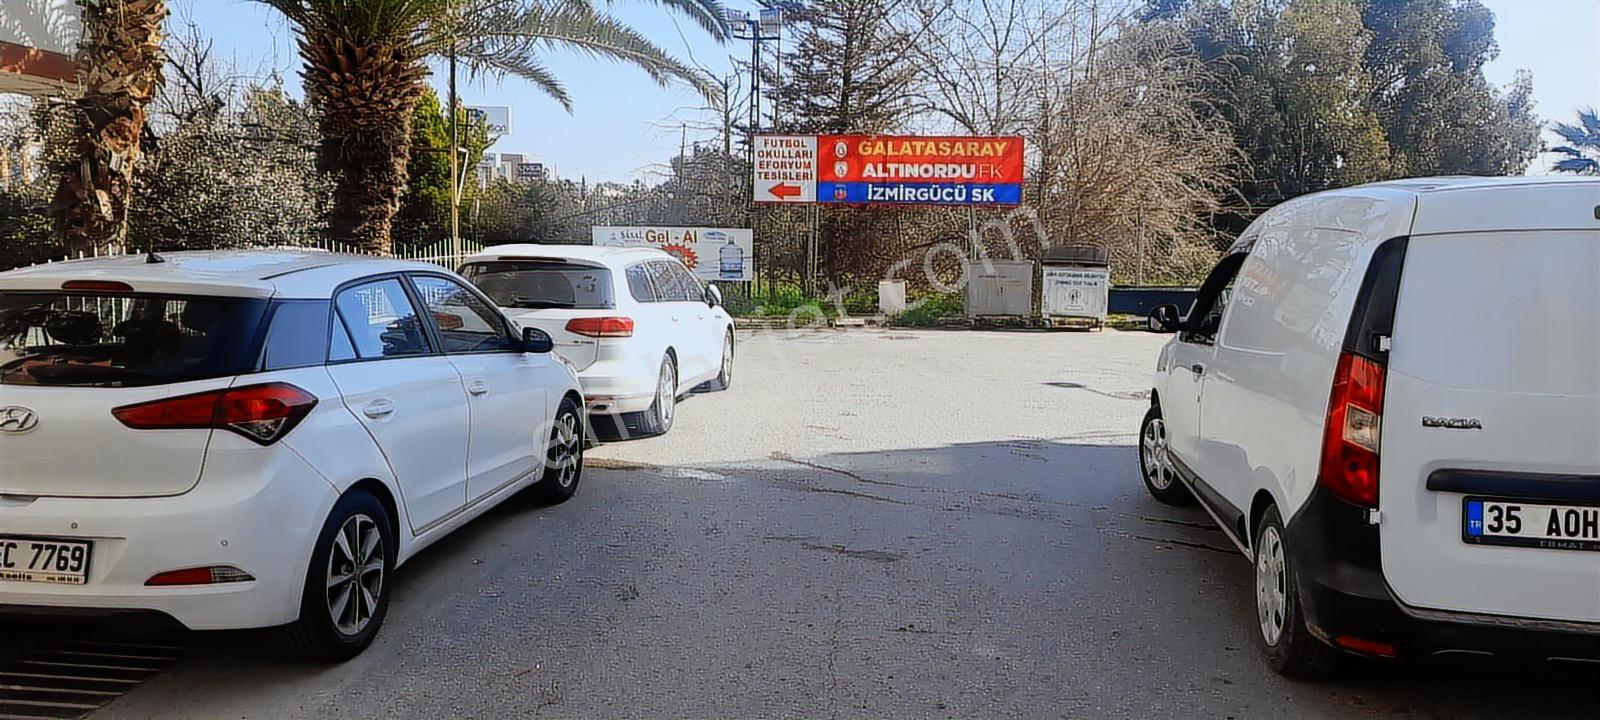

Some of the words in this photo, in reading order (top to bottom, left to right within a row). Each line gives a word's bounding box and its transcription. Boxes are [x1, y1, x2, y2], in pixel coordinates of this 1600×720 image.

[763, 139, 807, 148] FUTBOL
[858, 141, 1007, 157] GALATASARAY
[758, 149, 812, 159] OKULLARI
[759, 160, 811, 169] EFORYUM
[862, 162, 976, 178] ALTINORDU
[979, 163, 1003, 179] FK
[867, 184, 967, 201] İZMİRGÜCÜ
[971, 188, 995, 202] SK
[645, 229, 669, 243] Gel
[683, 230, 698, 244] Al
[1470, 520, 1482, 529] TR
[1487, 505, 1522, 534] 35
[1546, 508, 1599, 538] AOH
[28, 543, 84, 572] 7769
